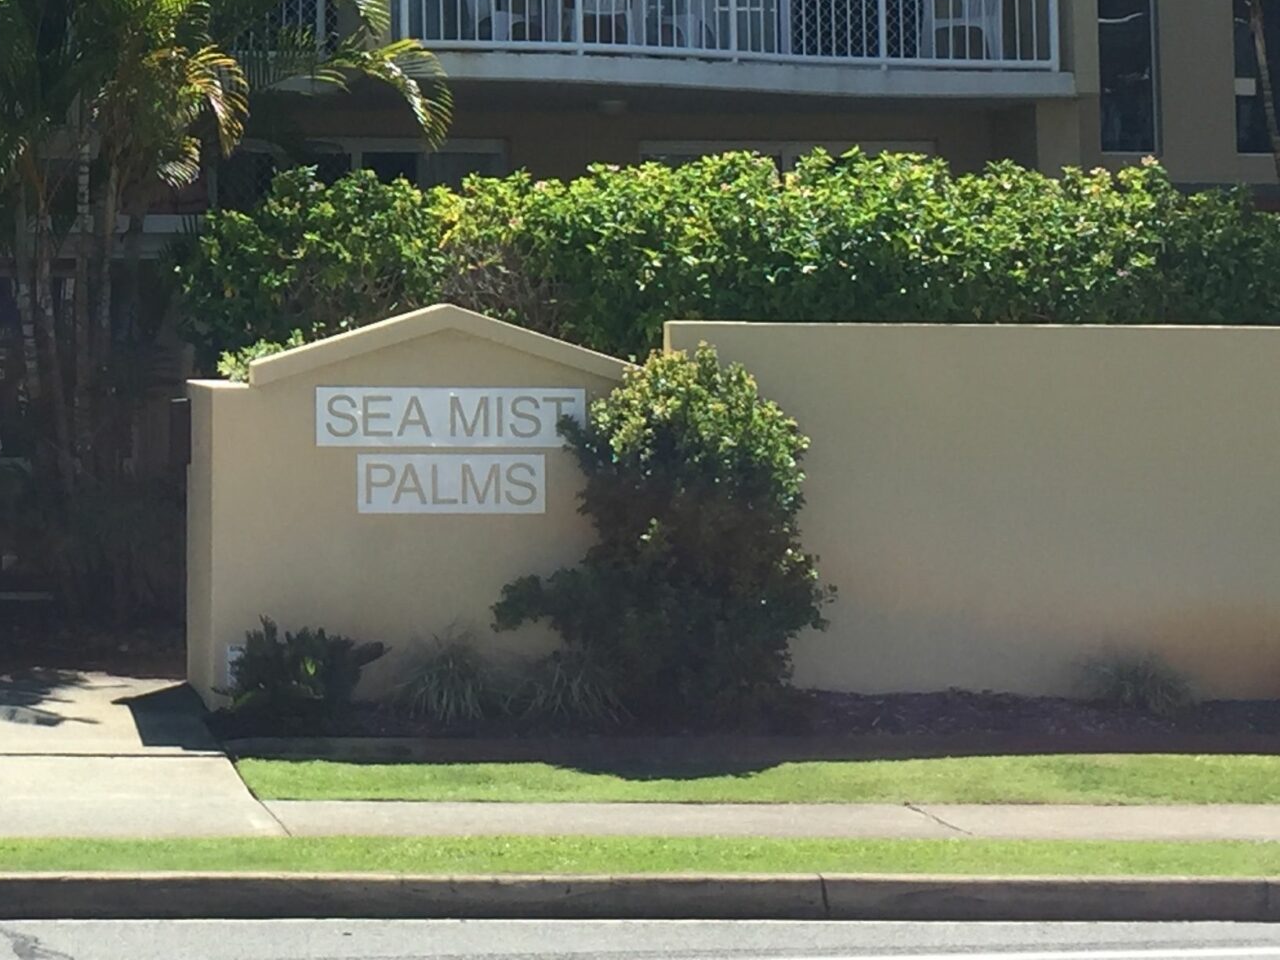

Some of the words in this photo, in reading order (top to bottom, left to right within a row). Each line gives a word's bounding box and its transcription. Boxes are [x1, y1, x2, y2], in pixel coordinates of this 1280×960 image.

[325, 394, 432, 438] SEA
[449, 395, 575, 438] MIST
[364, 462, 538, 506] PALMS
